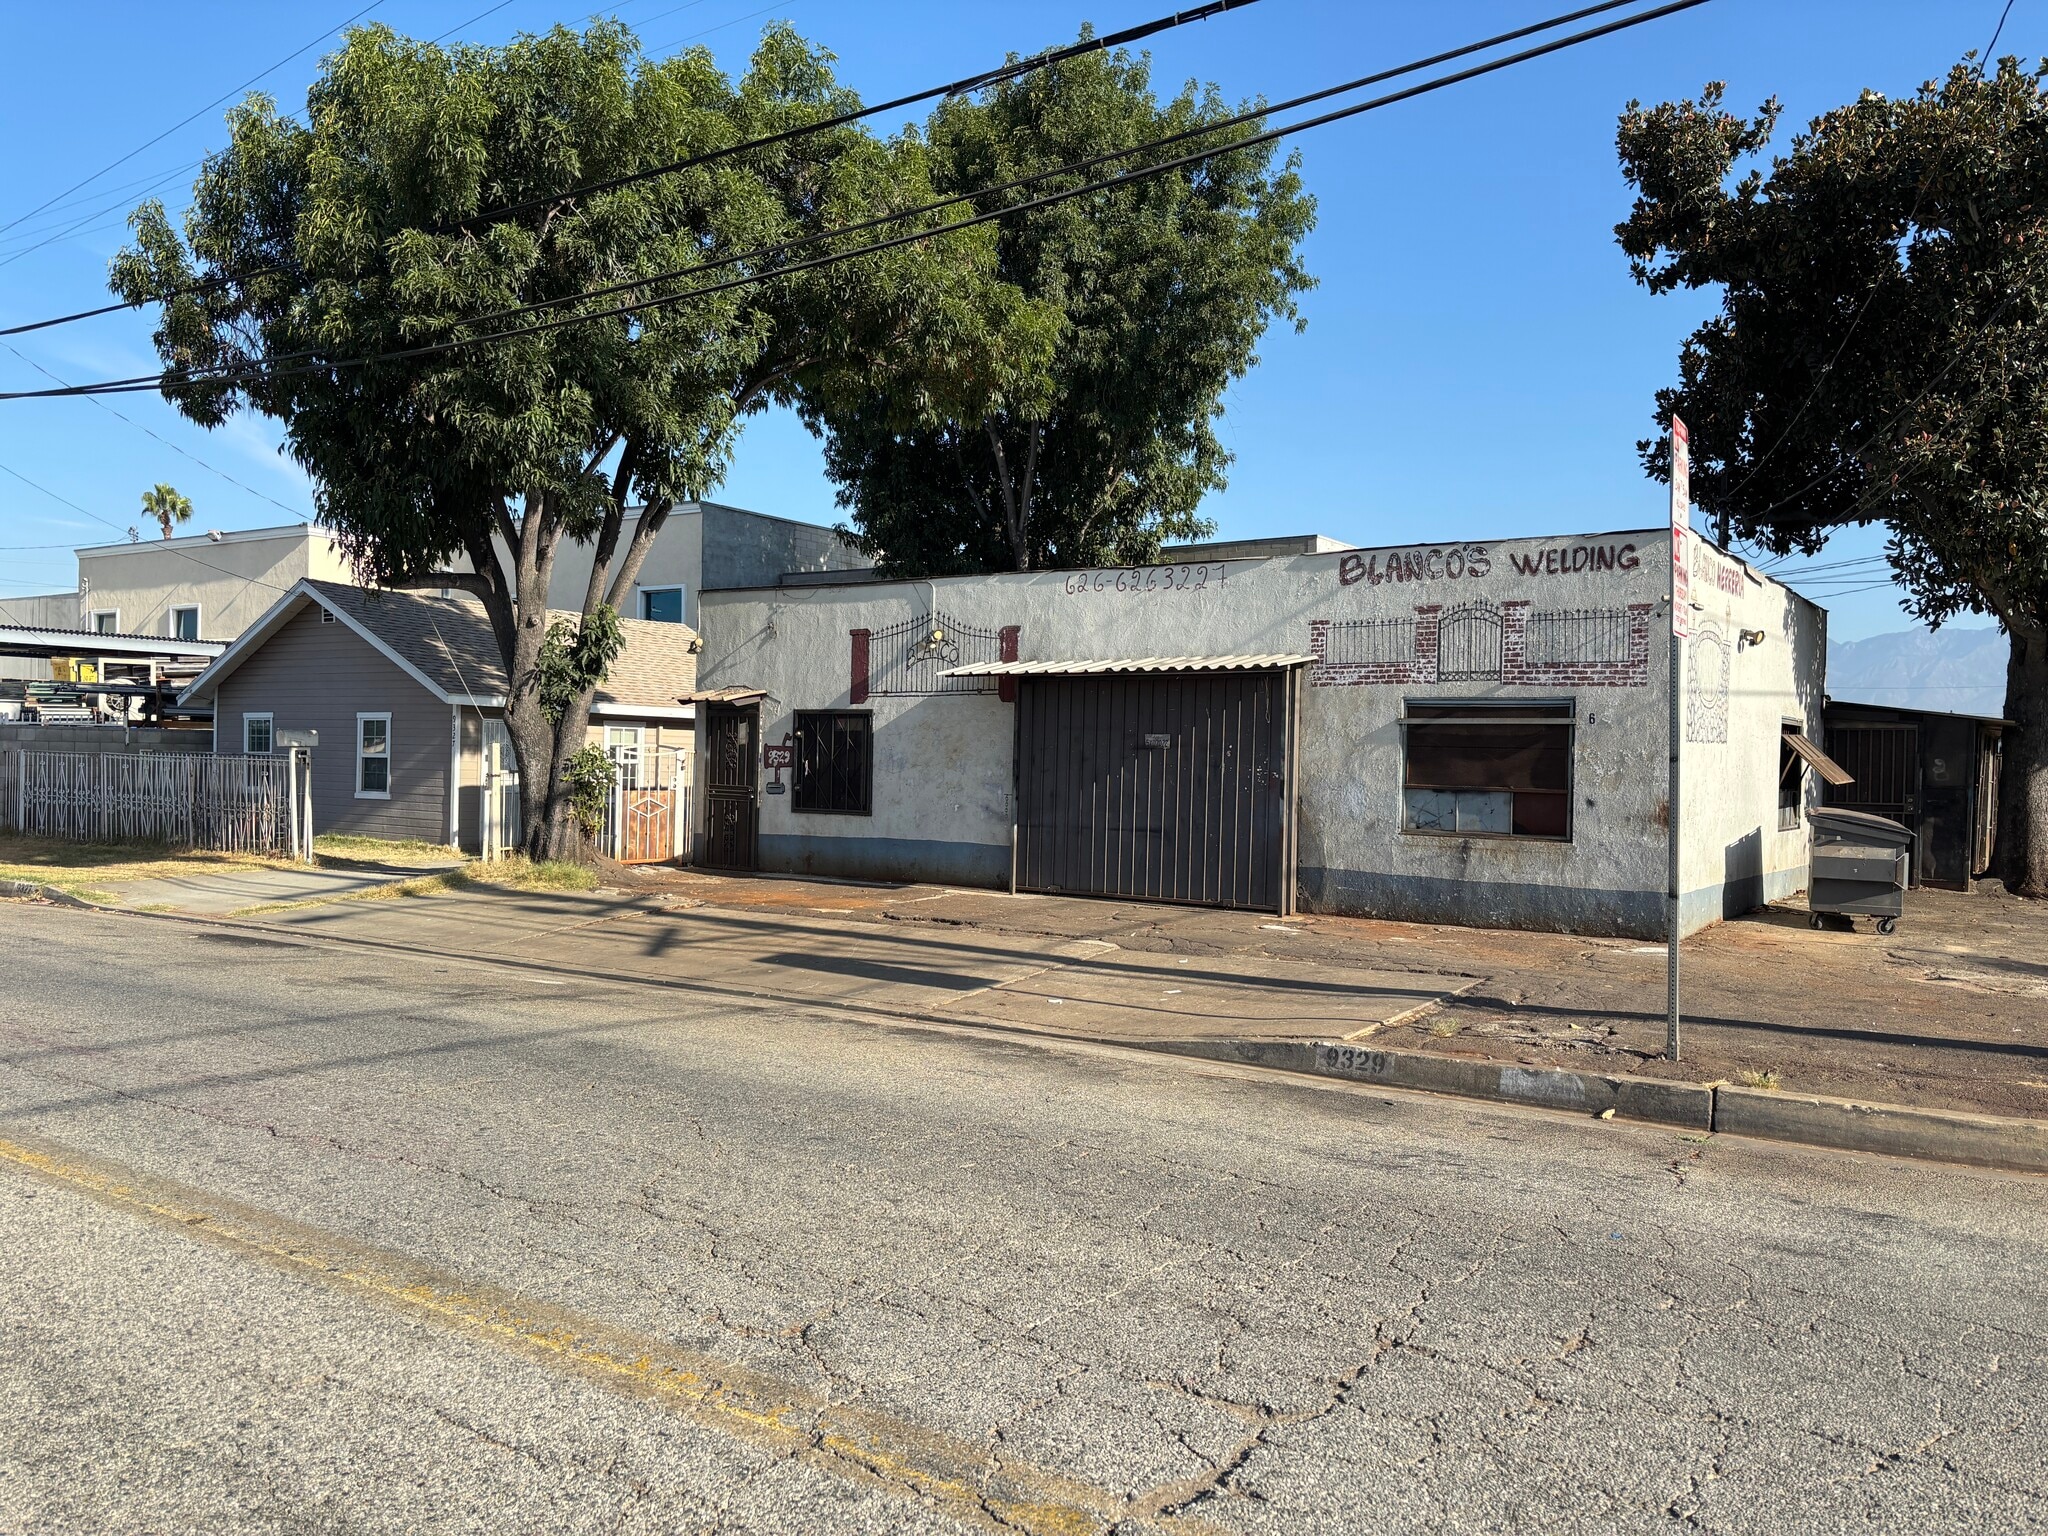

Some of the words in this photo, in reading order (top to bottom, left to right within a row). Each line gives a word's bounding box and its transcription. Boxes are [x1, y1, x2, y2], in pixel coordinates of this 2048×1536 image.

[1339, 544, 1491, 586] BLANCO'S
[1510, 544, 1640, 576] WELDING
[1588, 713, 1596, 725] 6
[1326, 1047, 1386, 1074] 9329
